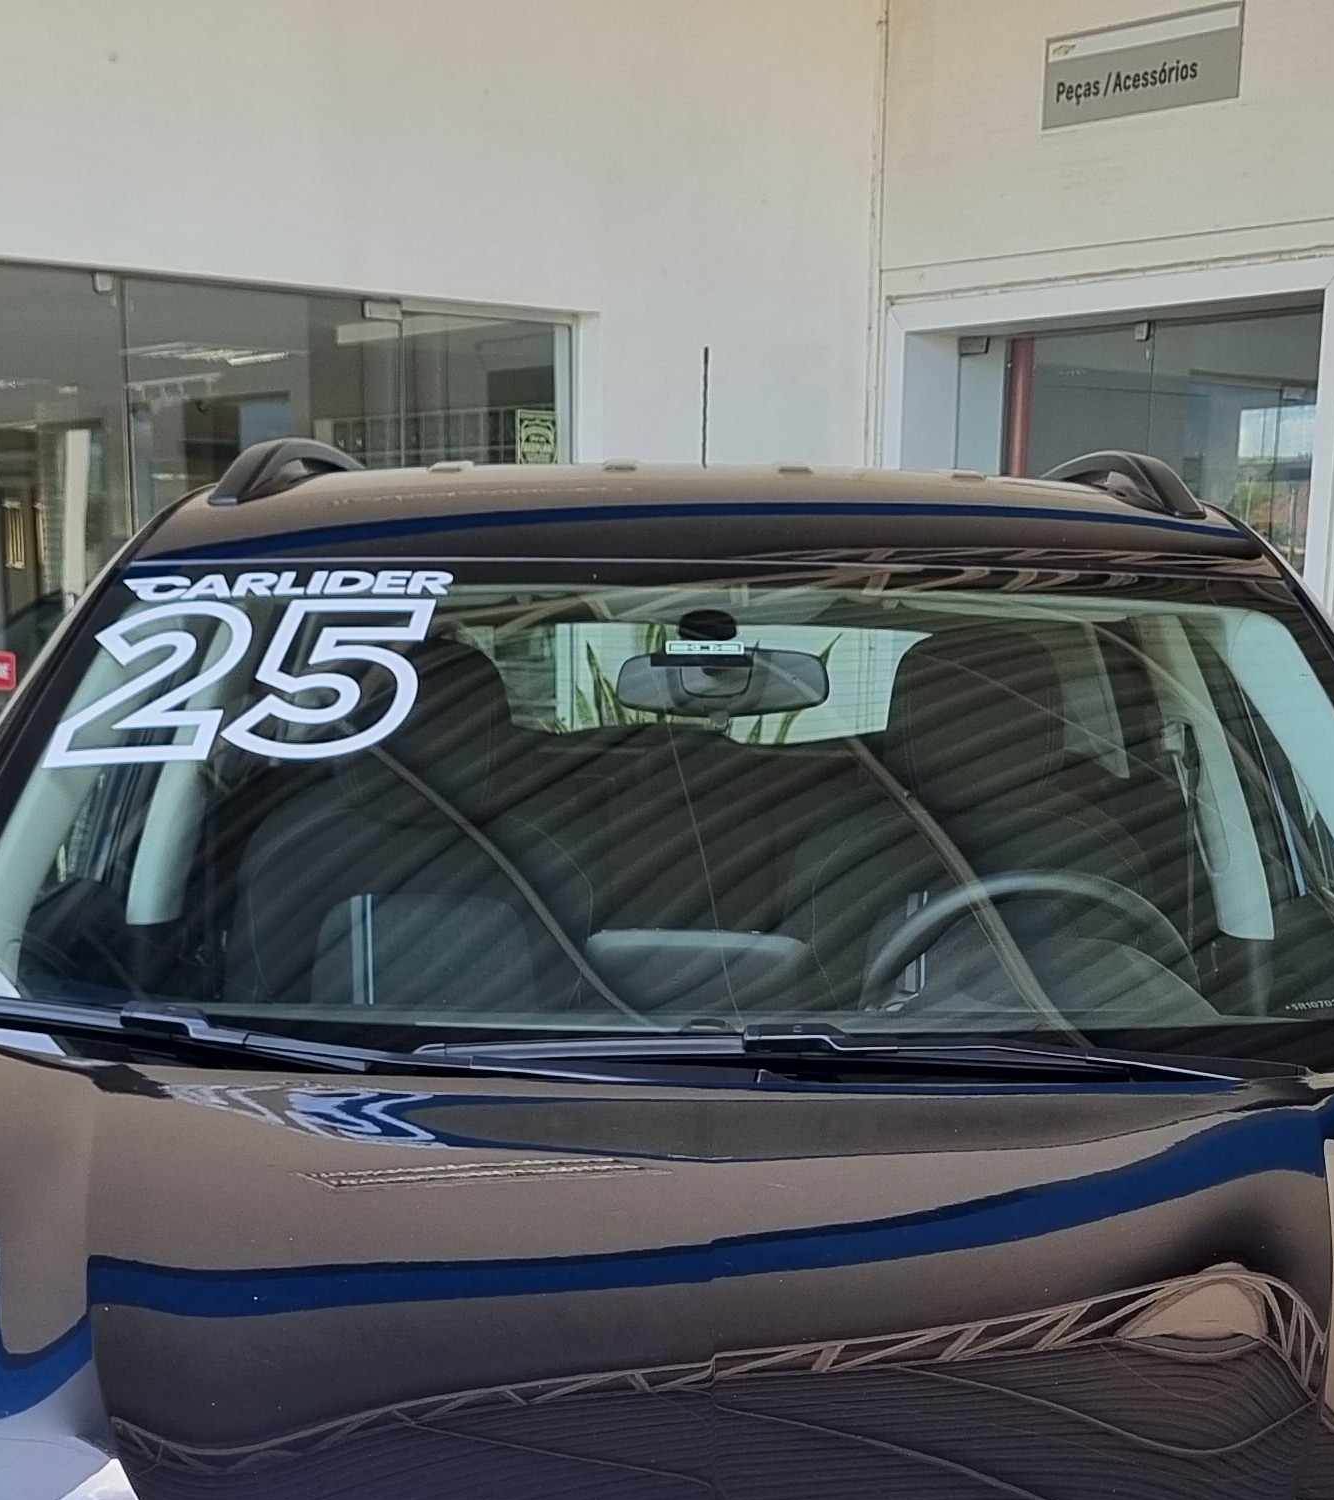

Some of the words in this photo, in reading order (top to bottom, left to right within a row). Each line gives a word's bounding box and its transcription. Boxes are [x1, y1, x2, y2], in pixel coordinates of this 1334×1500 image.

[1055, 77, 1100, 106] Peças
[123, 569, 454, 602] CARLIDER
[42, 598, 437, 769] 25
